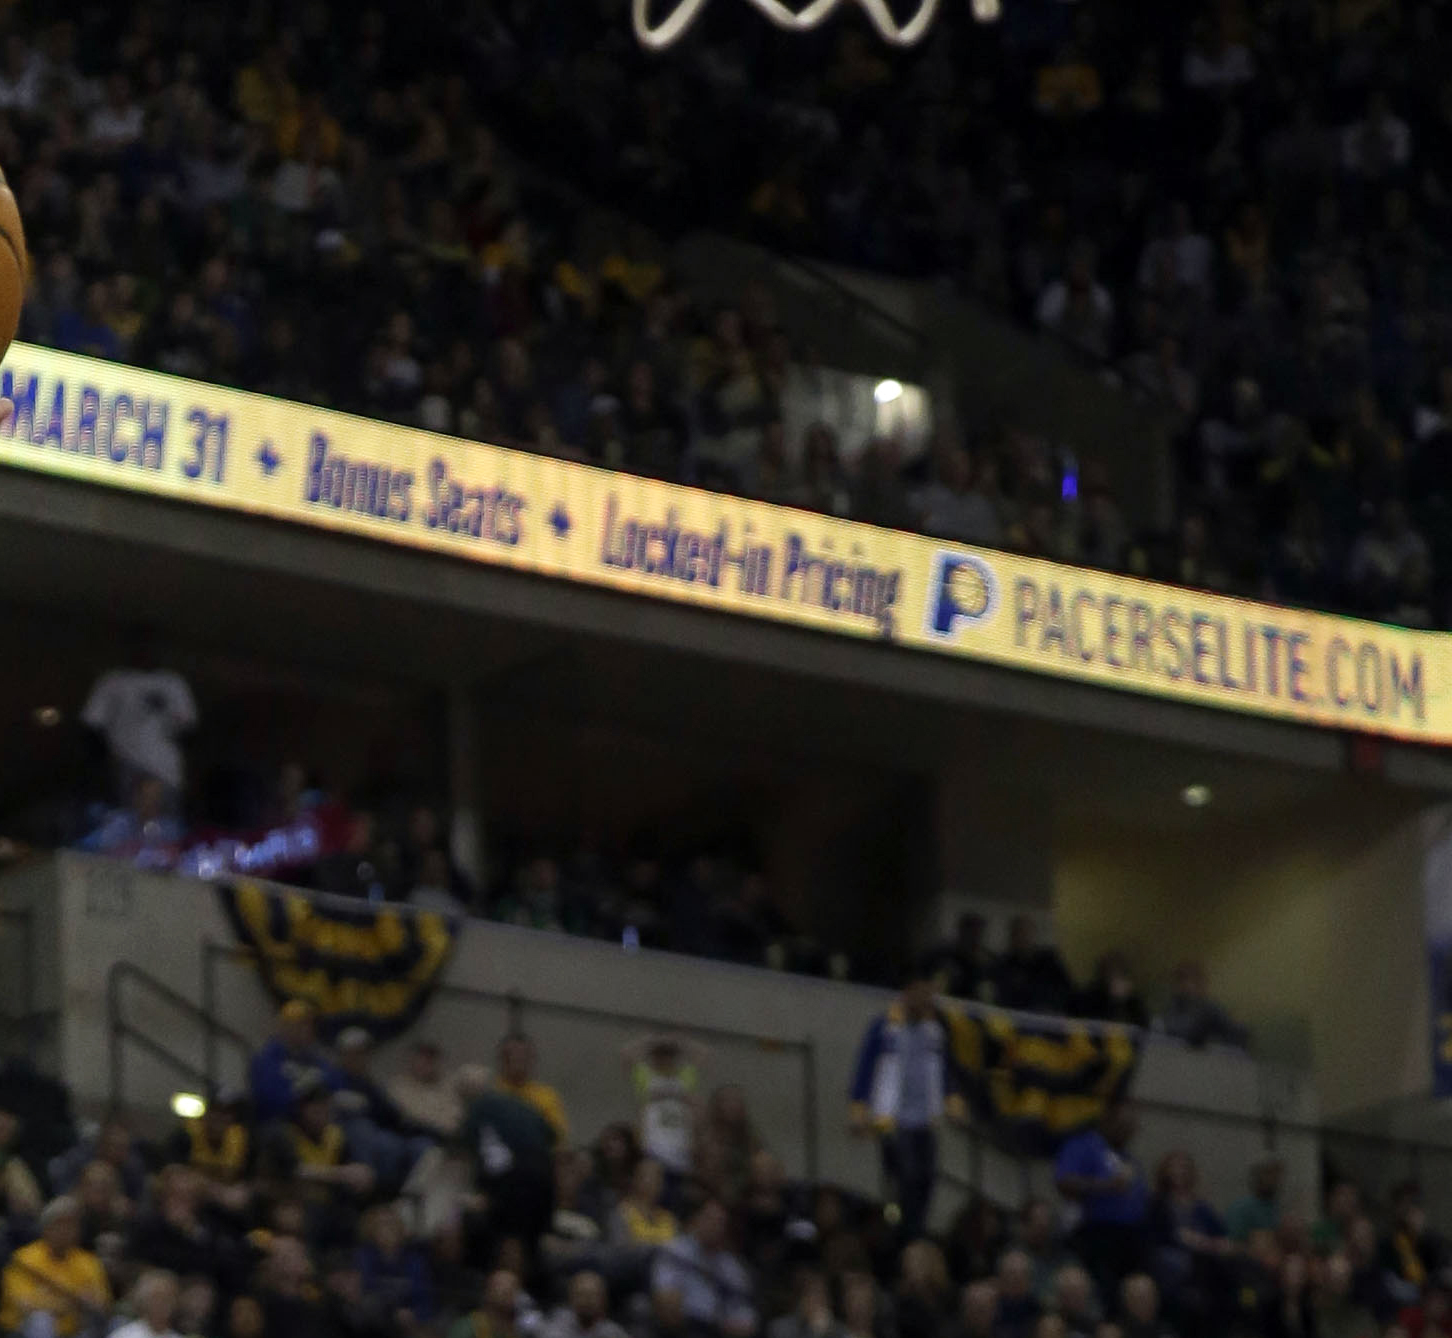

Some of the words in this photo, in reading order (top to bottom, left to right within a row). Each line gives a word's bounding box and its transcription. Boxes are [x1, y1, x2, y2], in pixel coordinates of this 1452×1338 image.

[184, 407, 230, 483] 31
[304, 432, 414, 522] Bonus
[426, 457, 525, 545] Seats
[601, 491, 771, 598] Locked-in
[782, 532, 902, 643] Pricing
[1013, 575, 1427, 723] PACERSELITE.COM
